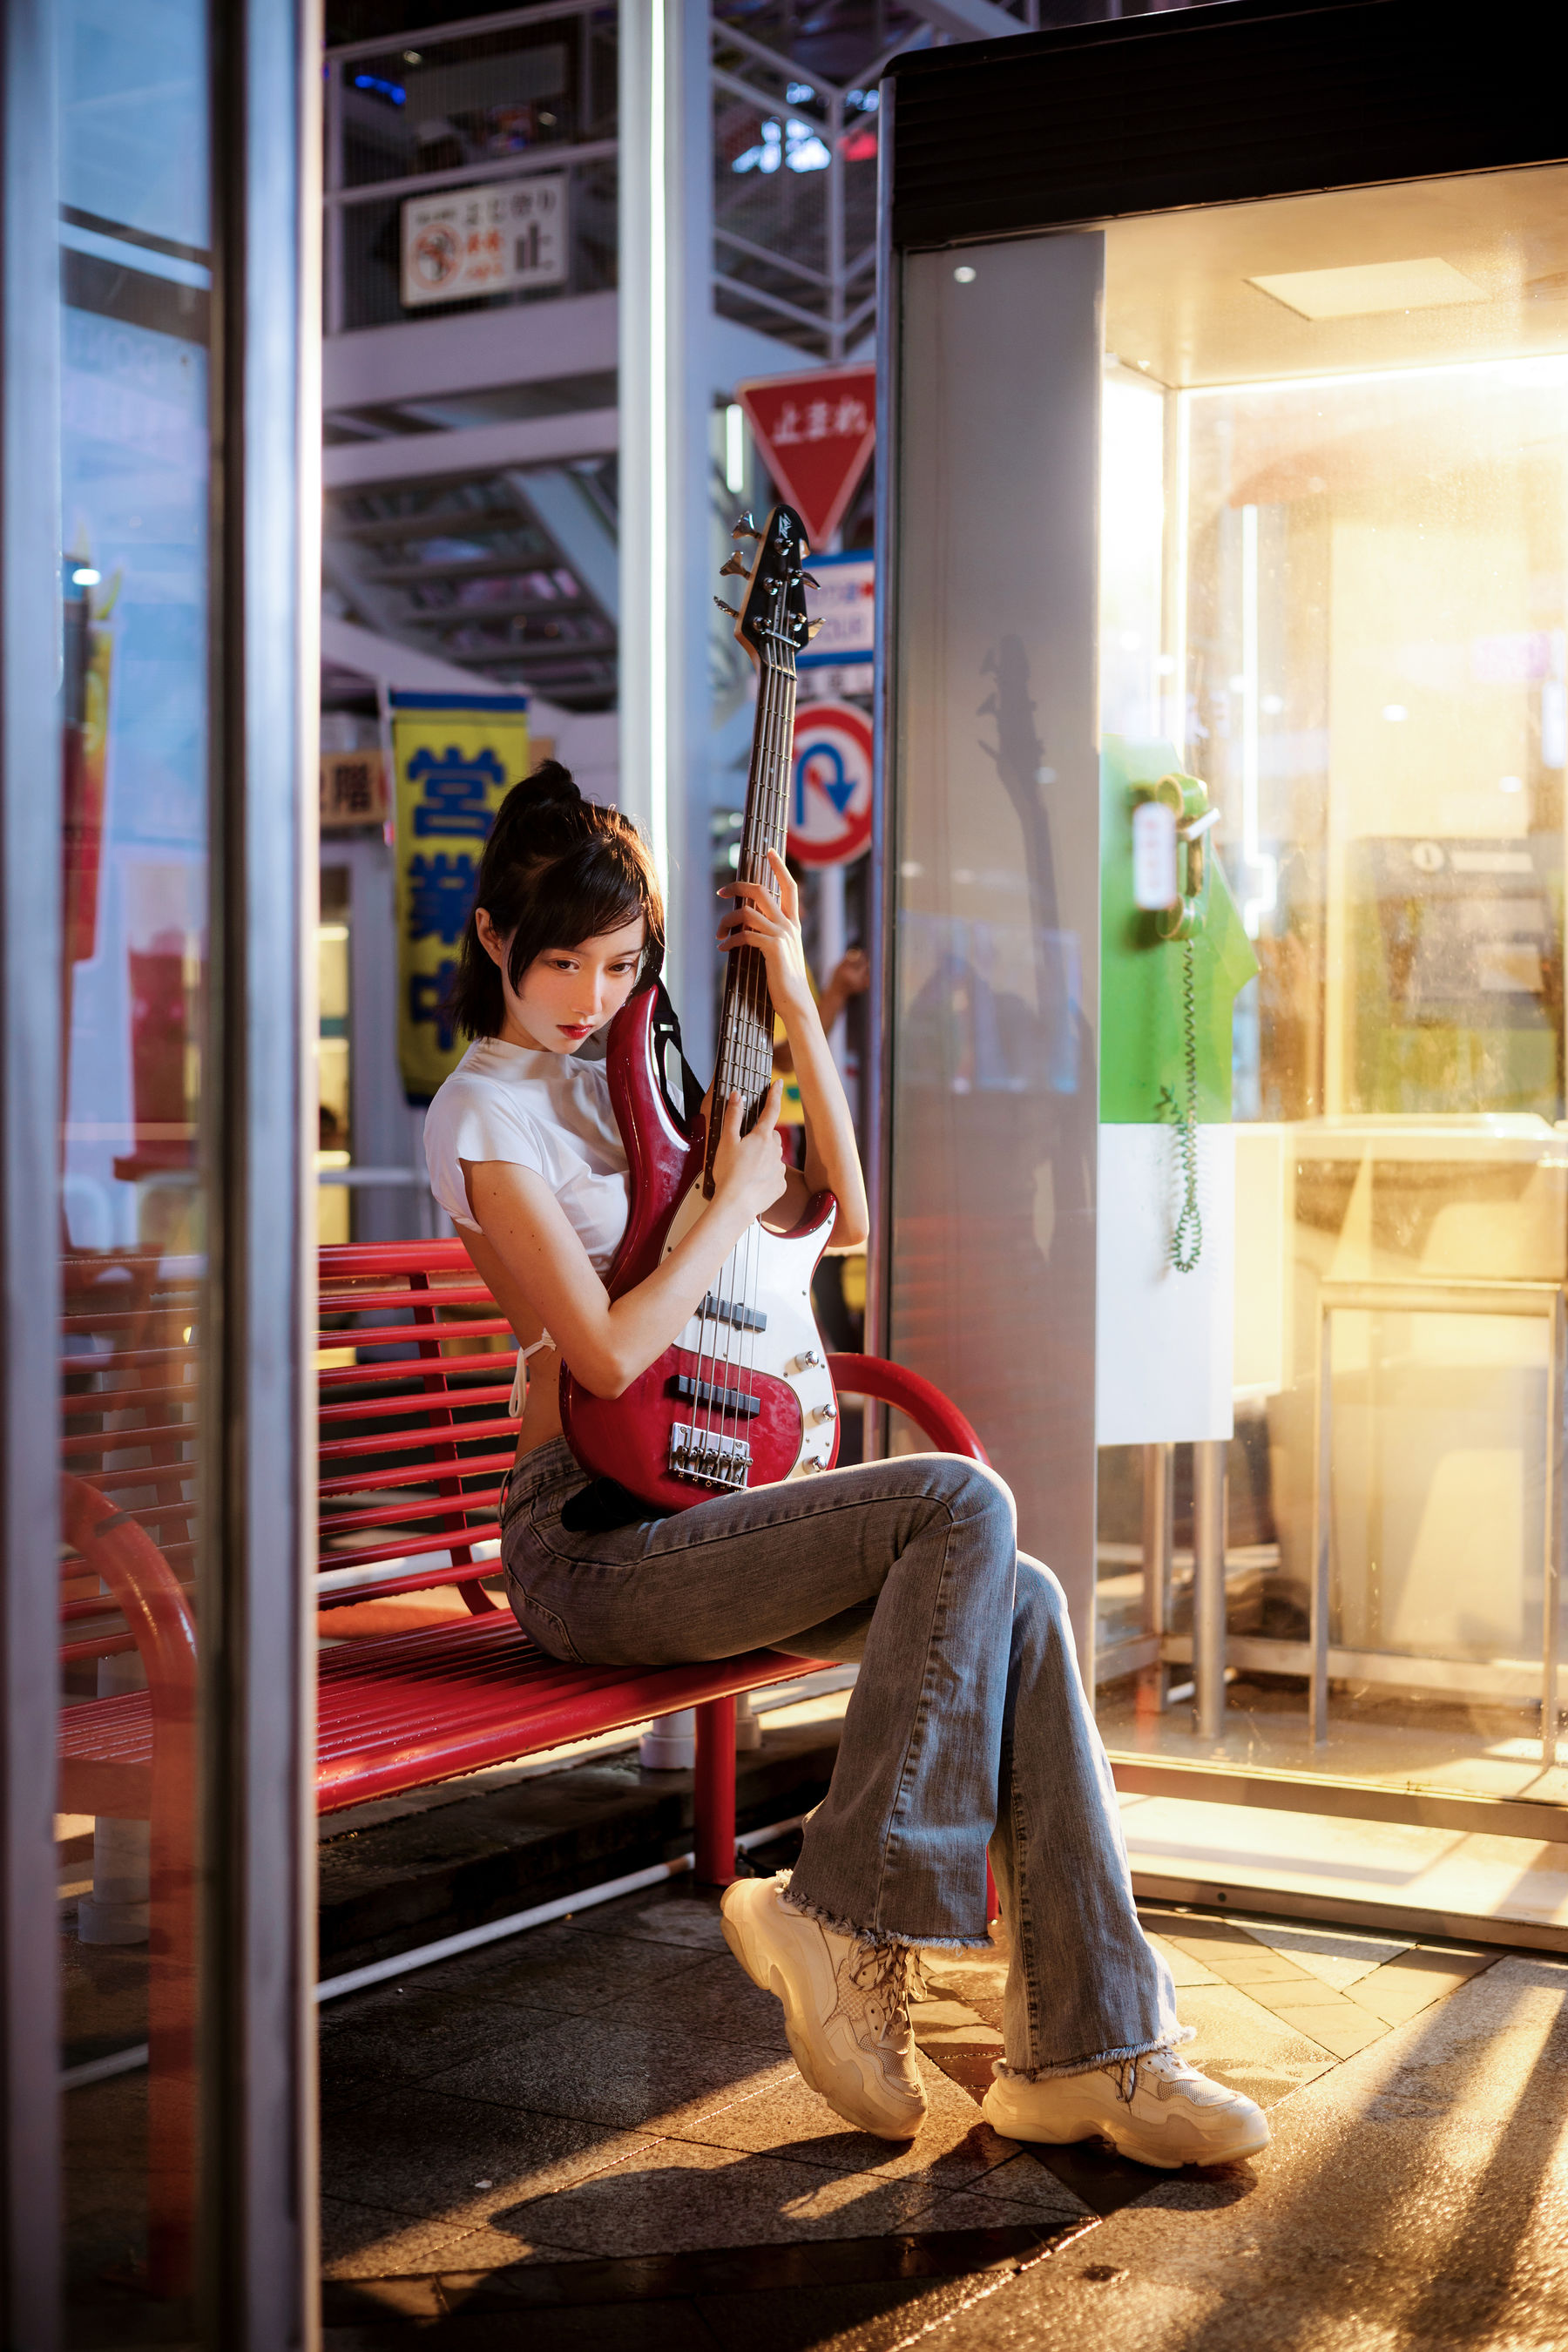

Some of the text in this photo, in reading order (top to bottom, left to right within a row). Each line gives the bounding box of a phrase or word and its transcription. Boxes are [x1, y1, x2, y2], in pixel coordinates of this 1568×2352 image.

[774, 396, 868, 446] 止まれ
[407, 745, 505, 1051] 営業中
